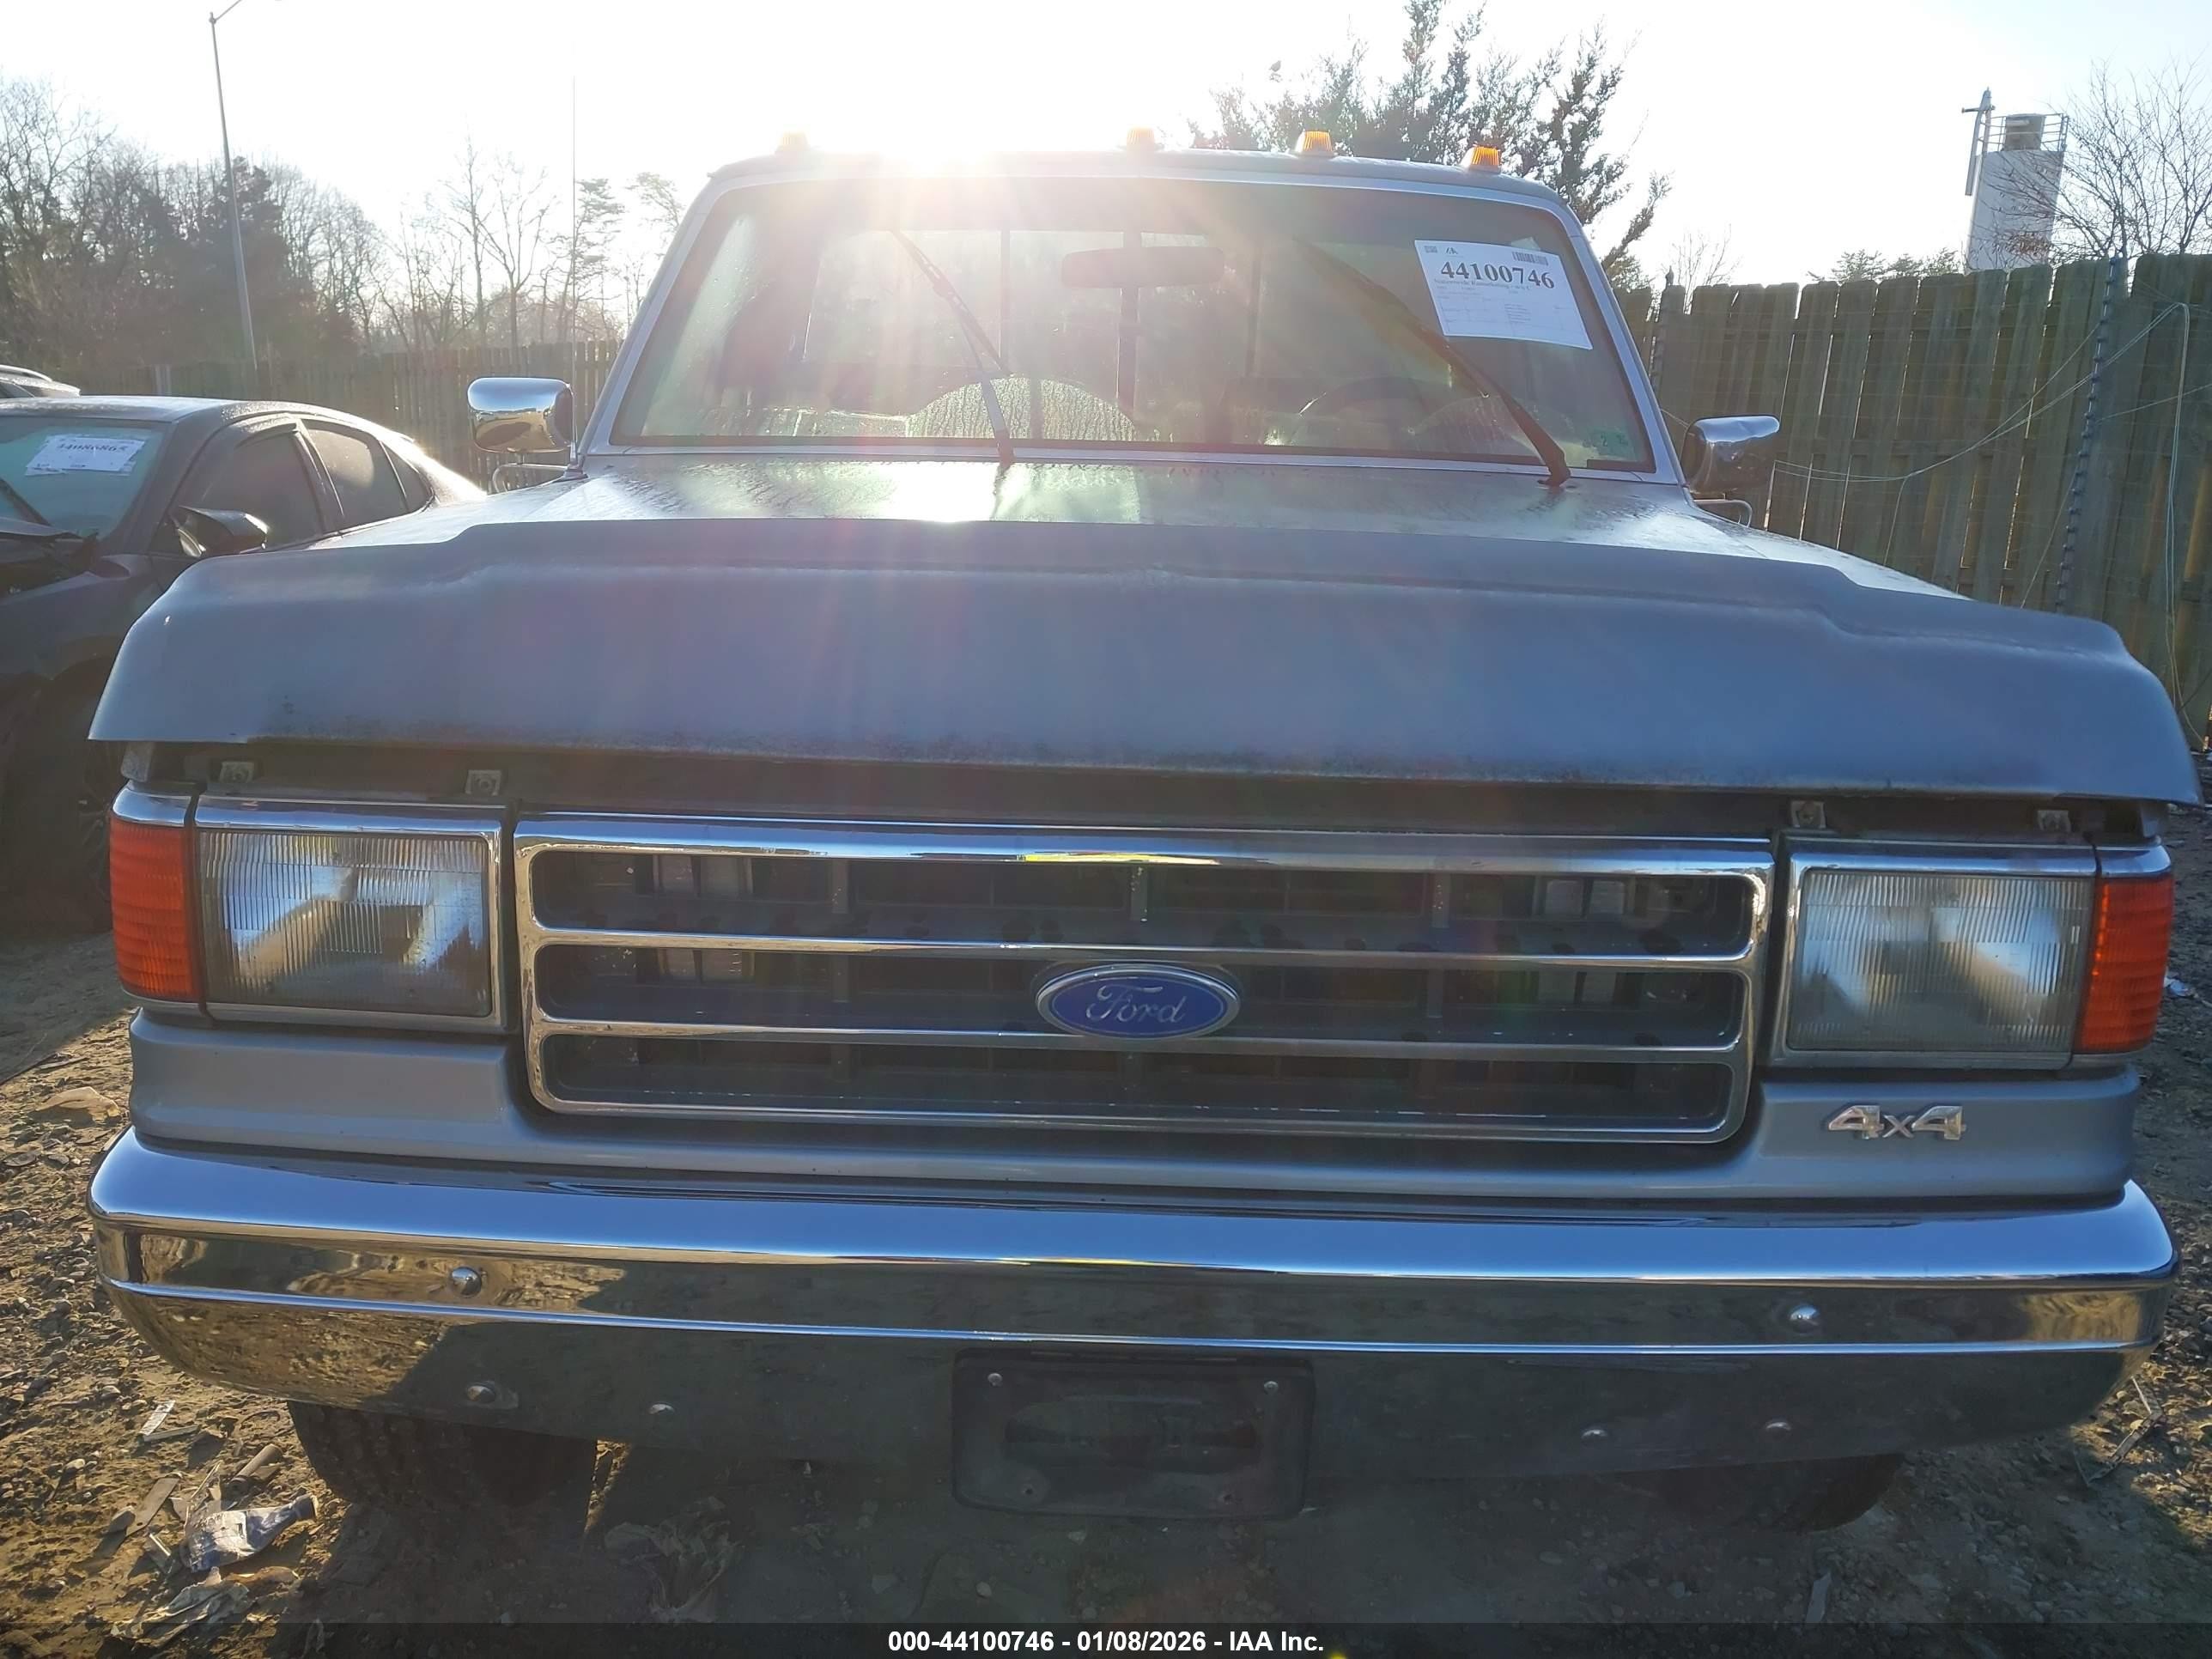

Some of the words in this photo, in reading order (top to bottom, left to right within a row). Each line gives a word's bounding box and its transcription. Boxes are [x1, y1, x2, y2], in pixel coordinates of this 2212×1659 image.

[1441, 261, 1555, 289] 44100746
[1086, 985, 1187, 1023] Ford
[1828, 1104, 1966, 1140] 4x4
